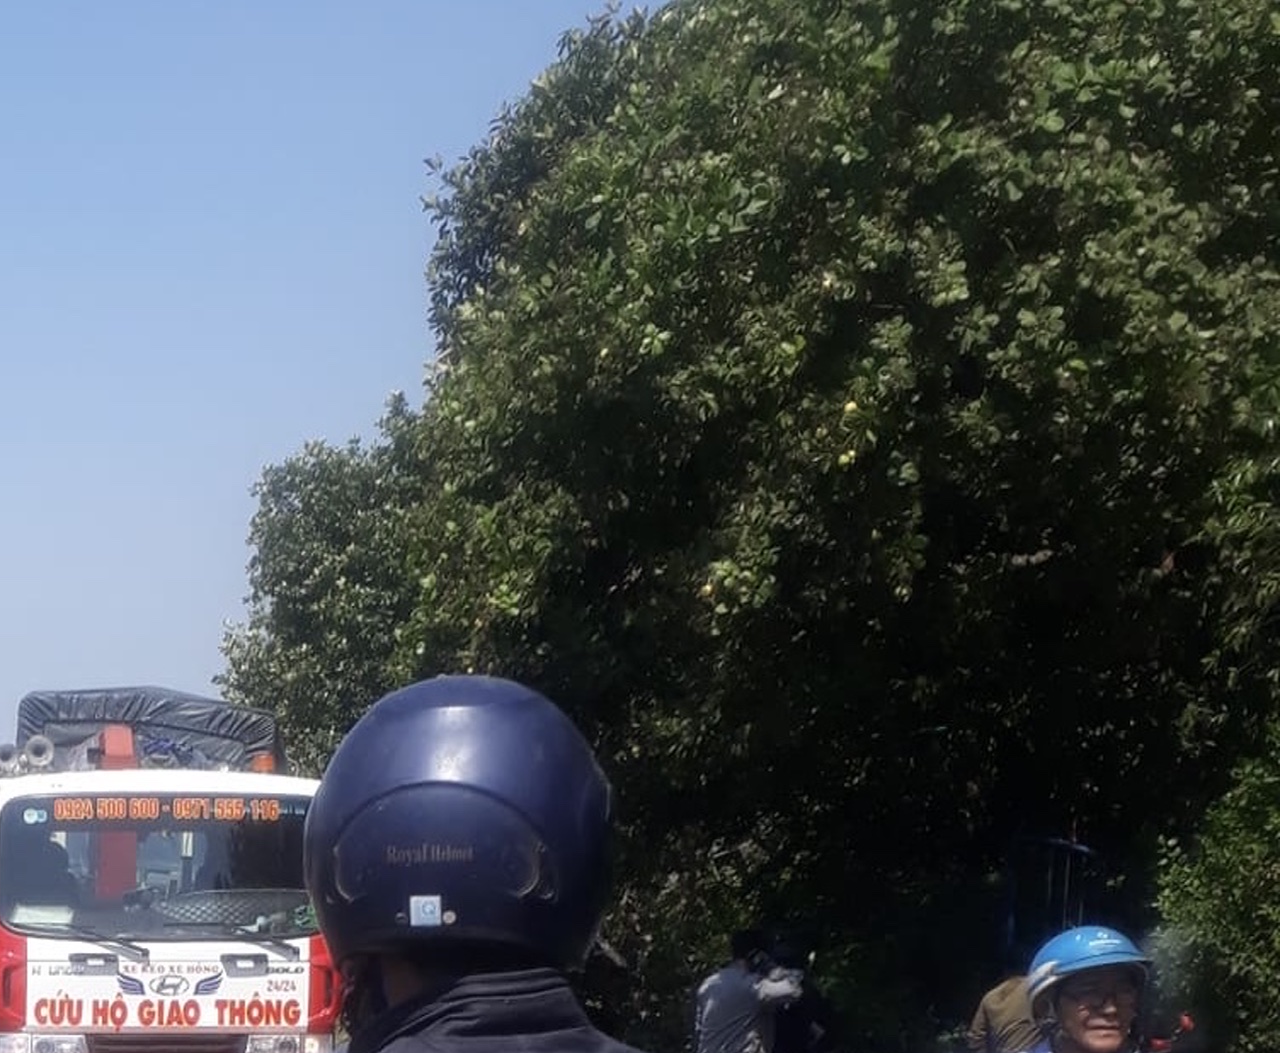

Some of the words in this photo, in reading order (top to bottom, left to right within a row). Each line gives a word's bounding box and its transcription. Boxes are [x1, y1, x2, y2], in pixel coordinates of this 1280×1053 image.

[96, 798, 127, 820] 500
[386, 843, 428, 867] Royal
[431, 843, 473, 862] Helmet
[34, 988, 83, 1025] CỨU
[92, 991, 128, 1031] HỘ
[137, 999, 202, 1026] GIAO
[214, 991, 301, 1026] THÔNG
